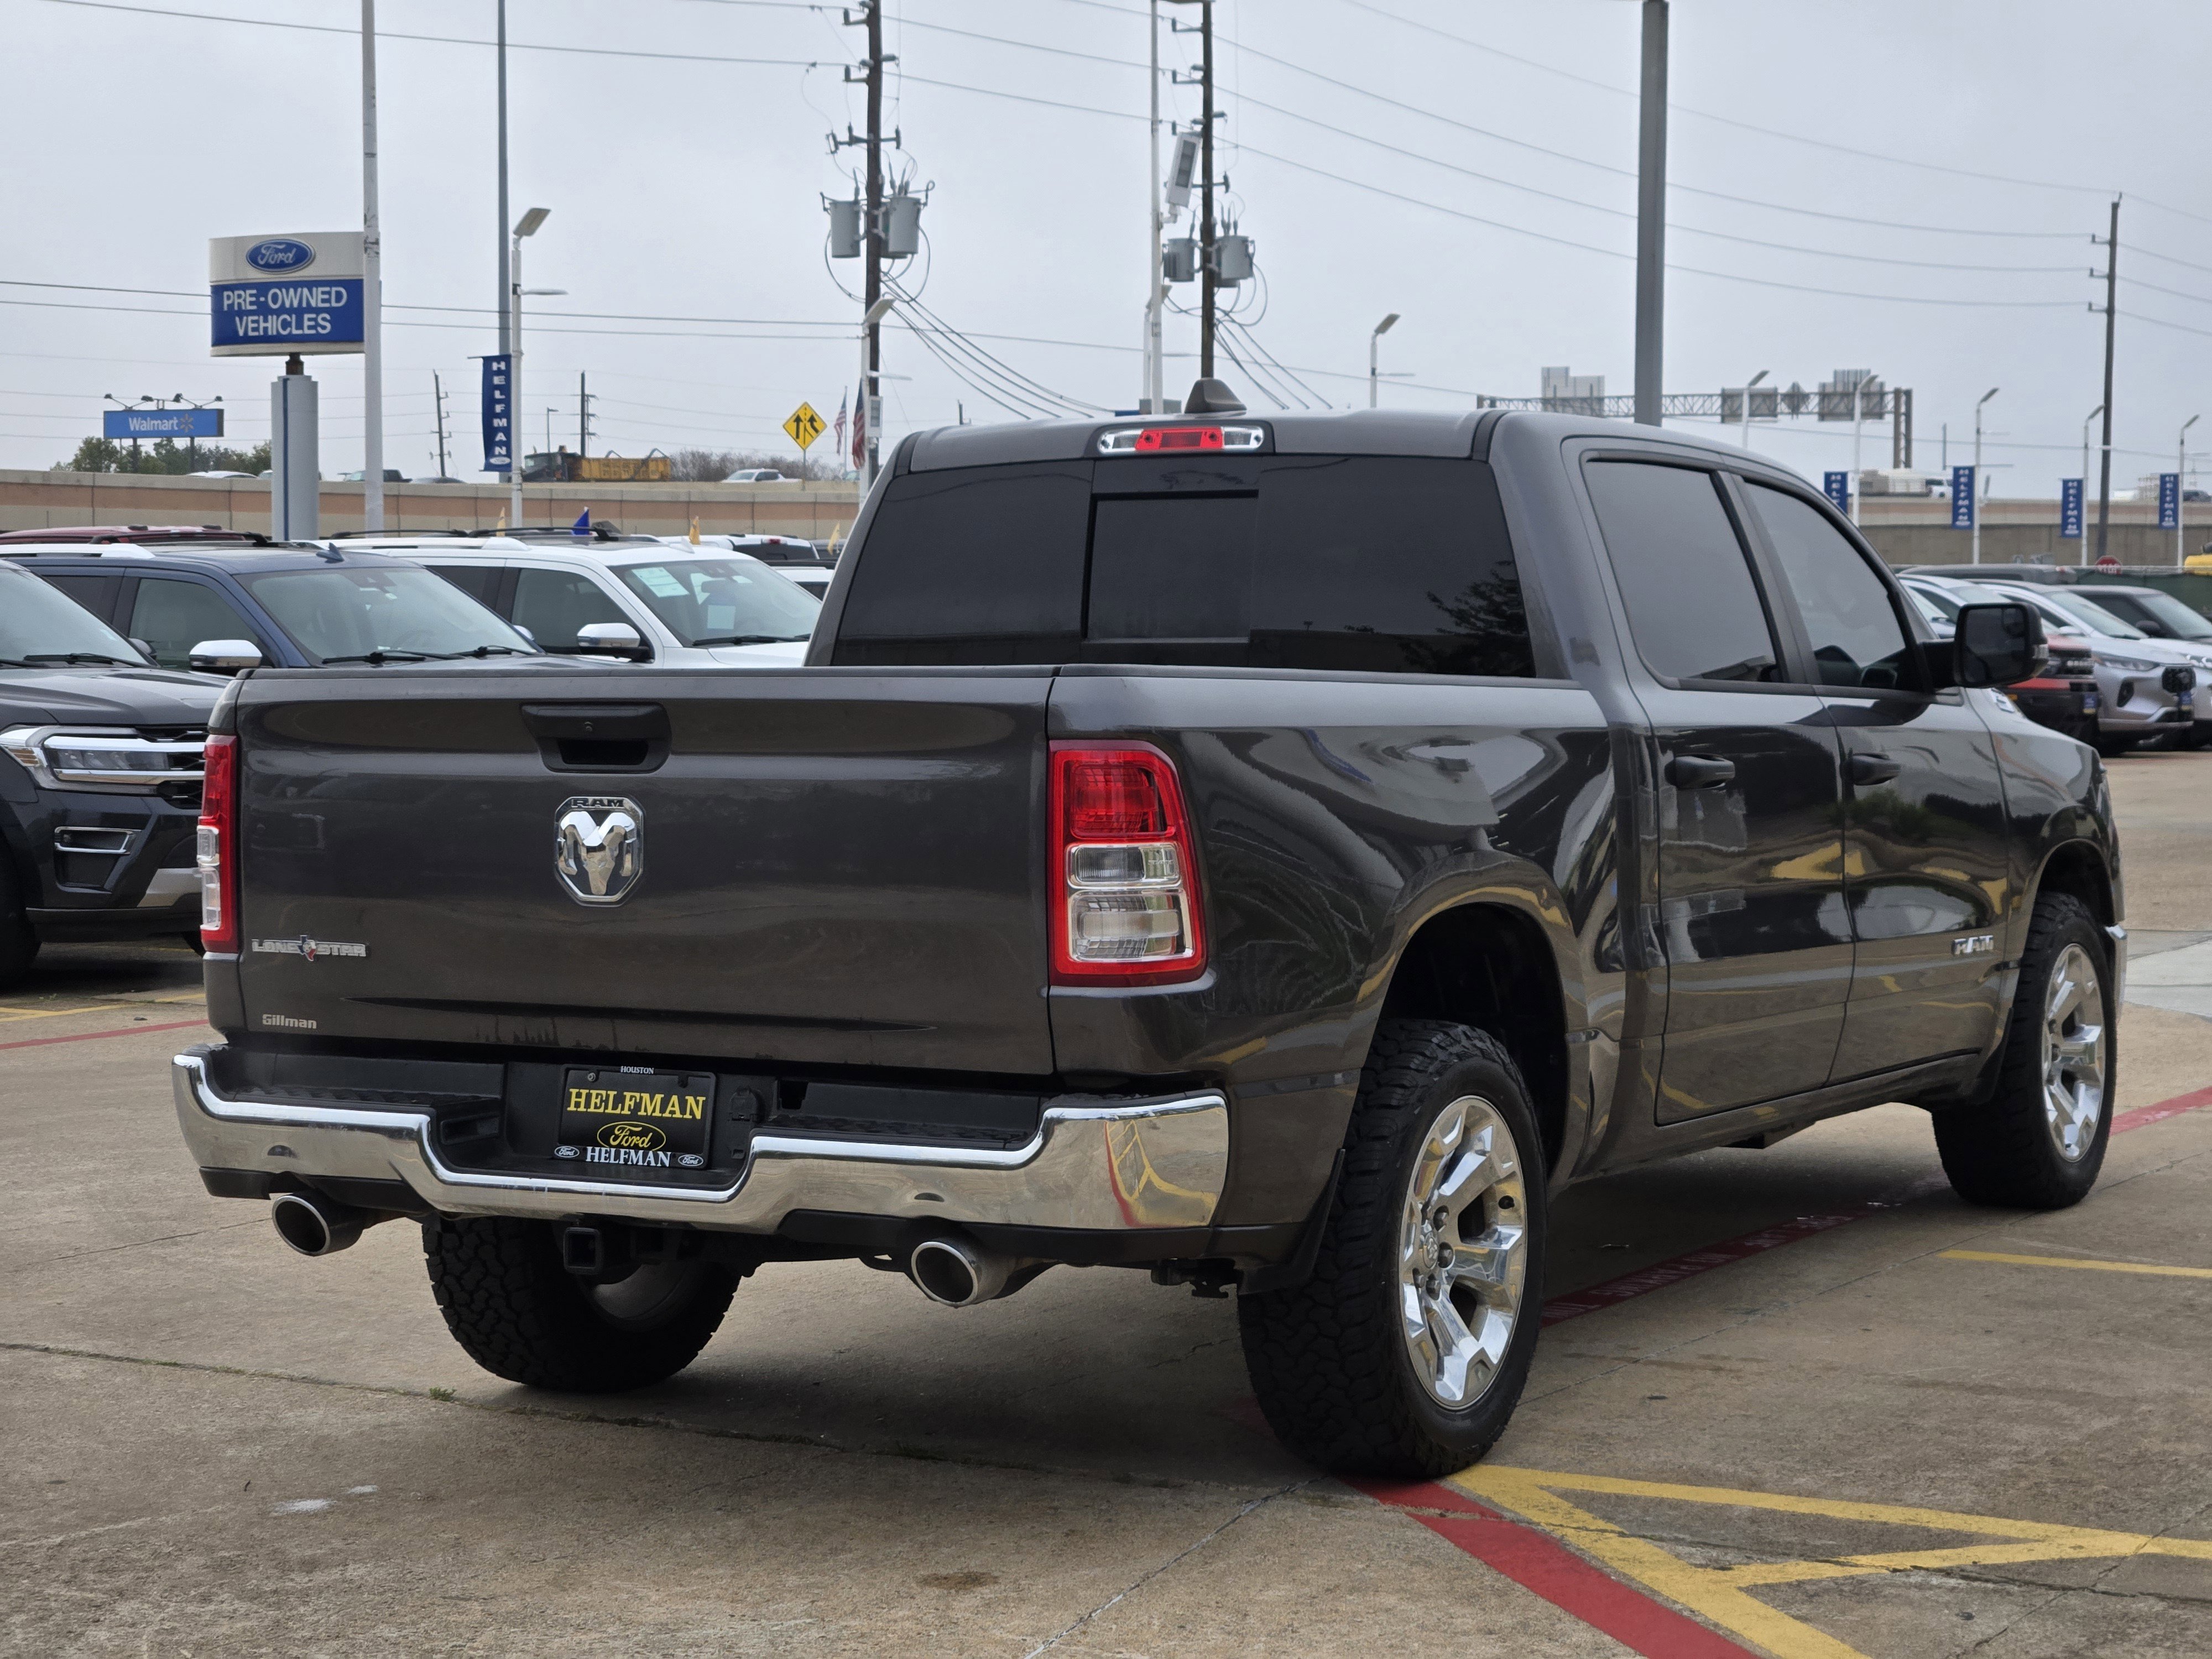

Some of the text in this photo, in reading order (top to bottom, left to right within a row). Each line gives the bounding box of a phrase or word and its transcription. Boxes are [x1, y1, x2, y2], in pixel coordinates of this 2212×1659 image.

[257, 243, 297, 265] Ford
[223, 286, 348, 311] PRE-OWNED
[234, 313, 332, 337] VEHICLES
[491, 361, 508, 455] HELFMAN
[128, 416, 178, 431] Walmart
[572, 799, 624, 807] RAM
[252, 939, 367, 957] LONE STAR
[262, 1014, 317, 1029] Gillman
[620, 1066, 654, 1074] HOUSTON
[567, 1088, 706, 1119] HELFMAN
[611, 1125, 653, 1147] Ford
[558, 1147, 575, 1156] Ford
[586, 1146, 671, 1167] HELFMAN
[682, 1156, 700, 1165] Ford
